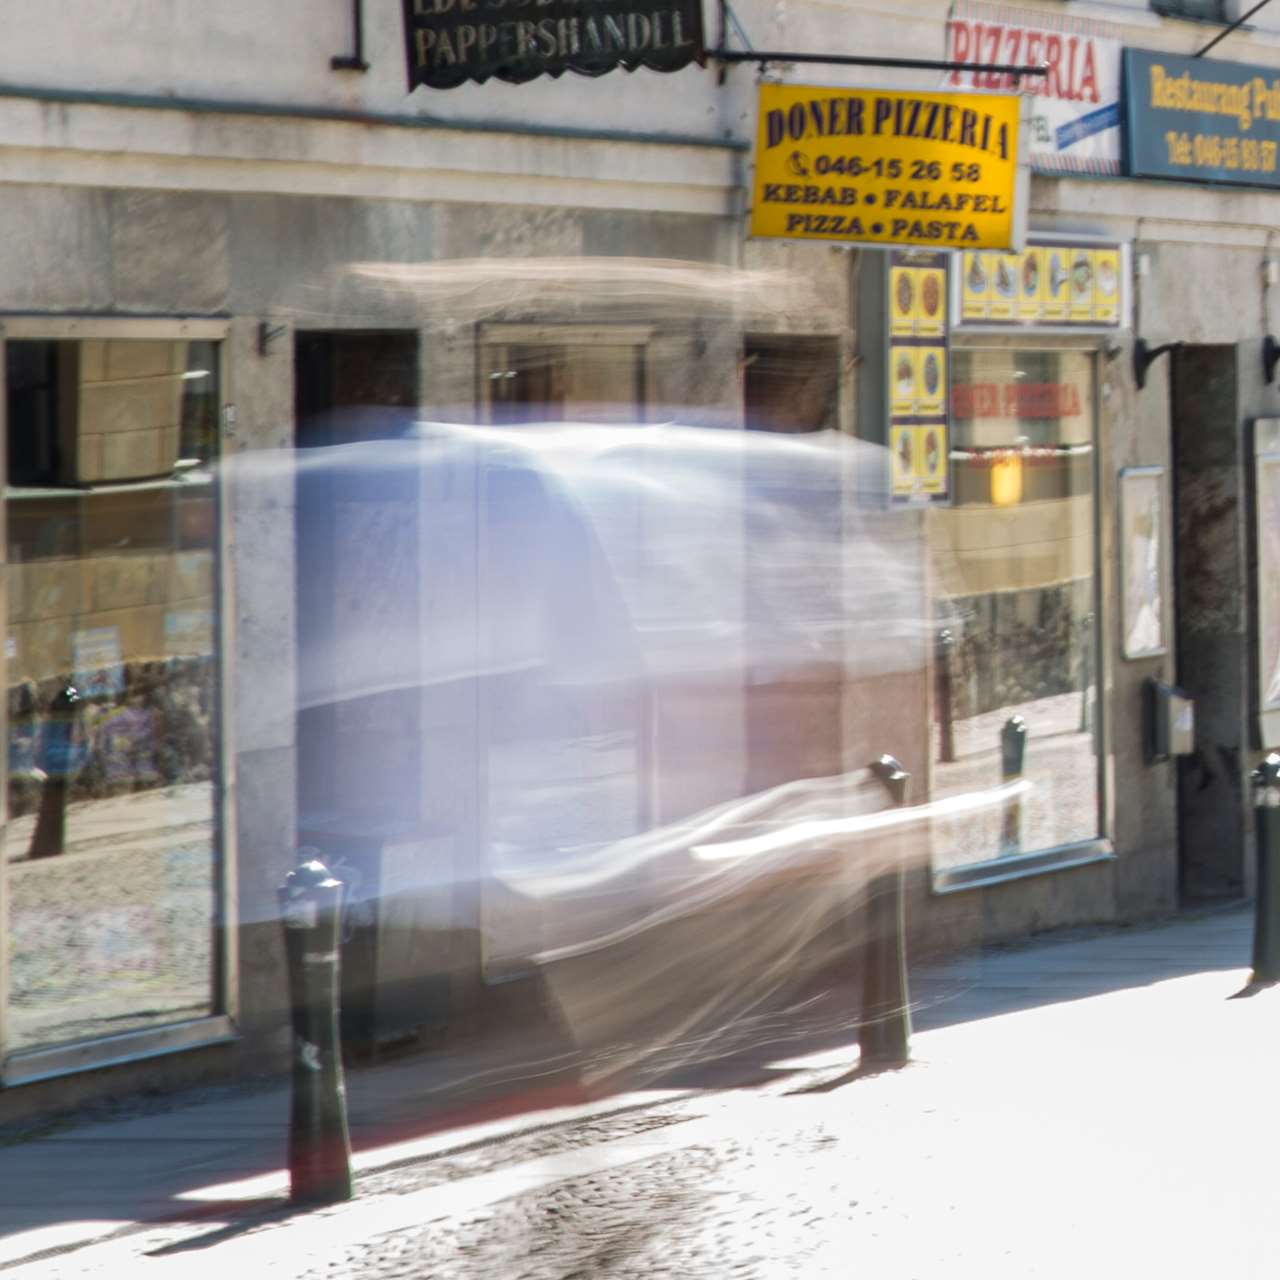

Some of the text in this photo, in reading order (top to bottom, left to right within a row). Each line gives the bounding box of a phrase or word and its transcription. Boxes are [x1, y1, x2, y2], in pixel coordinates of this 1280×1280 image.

[415, 10, 694, 67] PAPPERSHANDEL
[949, 21, 1100, 103] PIZZERIA
[1150, 64, 1252, 131] Restaurang
[766, 97, 866, 149] DONER
[873, 98, 1009, 160] PIZZERIA
[815, 154, 981, 183] 046-15 26 58
[762, 183, 1006, 213] KEBAB FALAFEL
[786, 213, 980, 242] PIZZA PASTA
